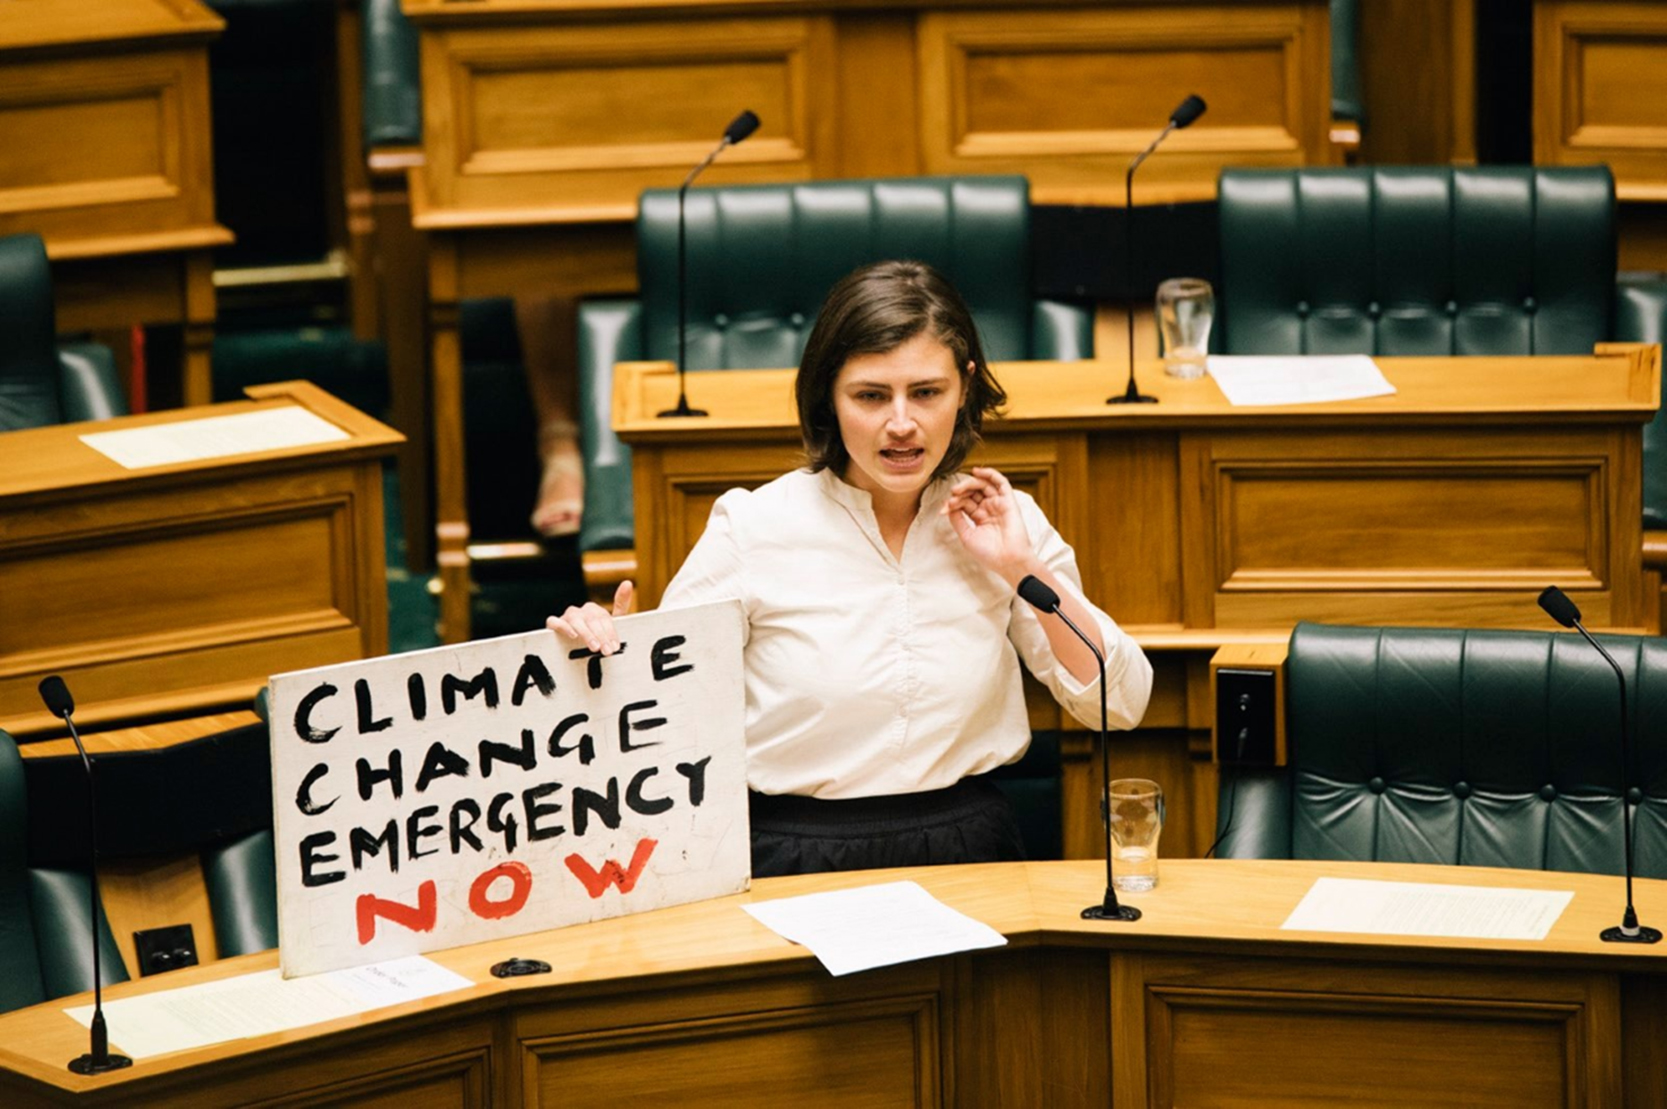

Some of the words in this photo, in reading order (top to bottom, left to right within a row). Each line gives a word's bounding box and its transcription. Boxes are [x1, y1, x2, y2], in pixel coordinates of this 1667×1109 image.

[294, 635, 695, 743] CLIMATE
[296, 699, 668, 816] CHANGE
[299, 756, 712, 887] EMERGENCY
[356, 838, 658, 944] NOW
